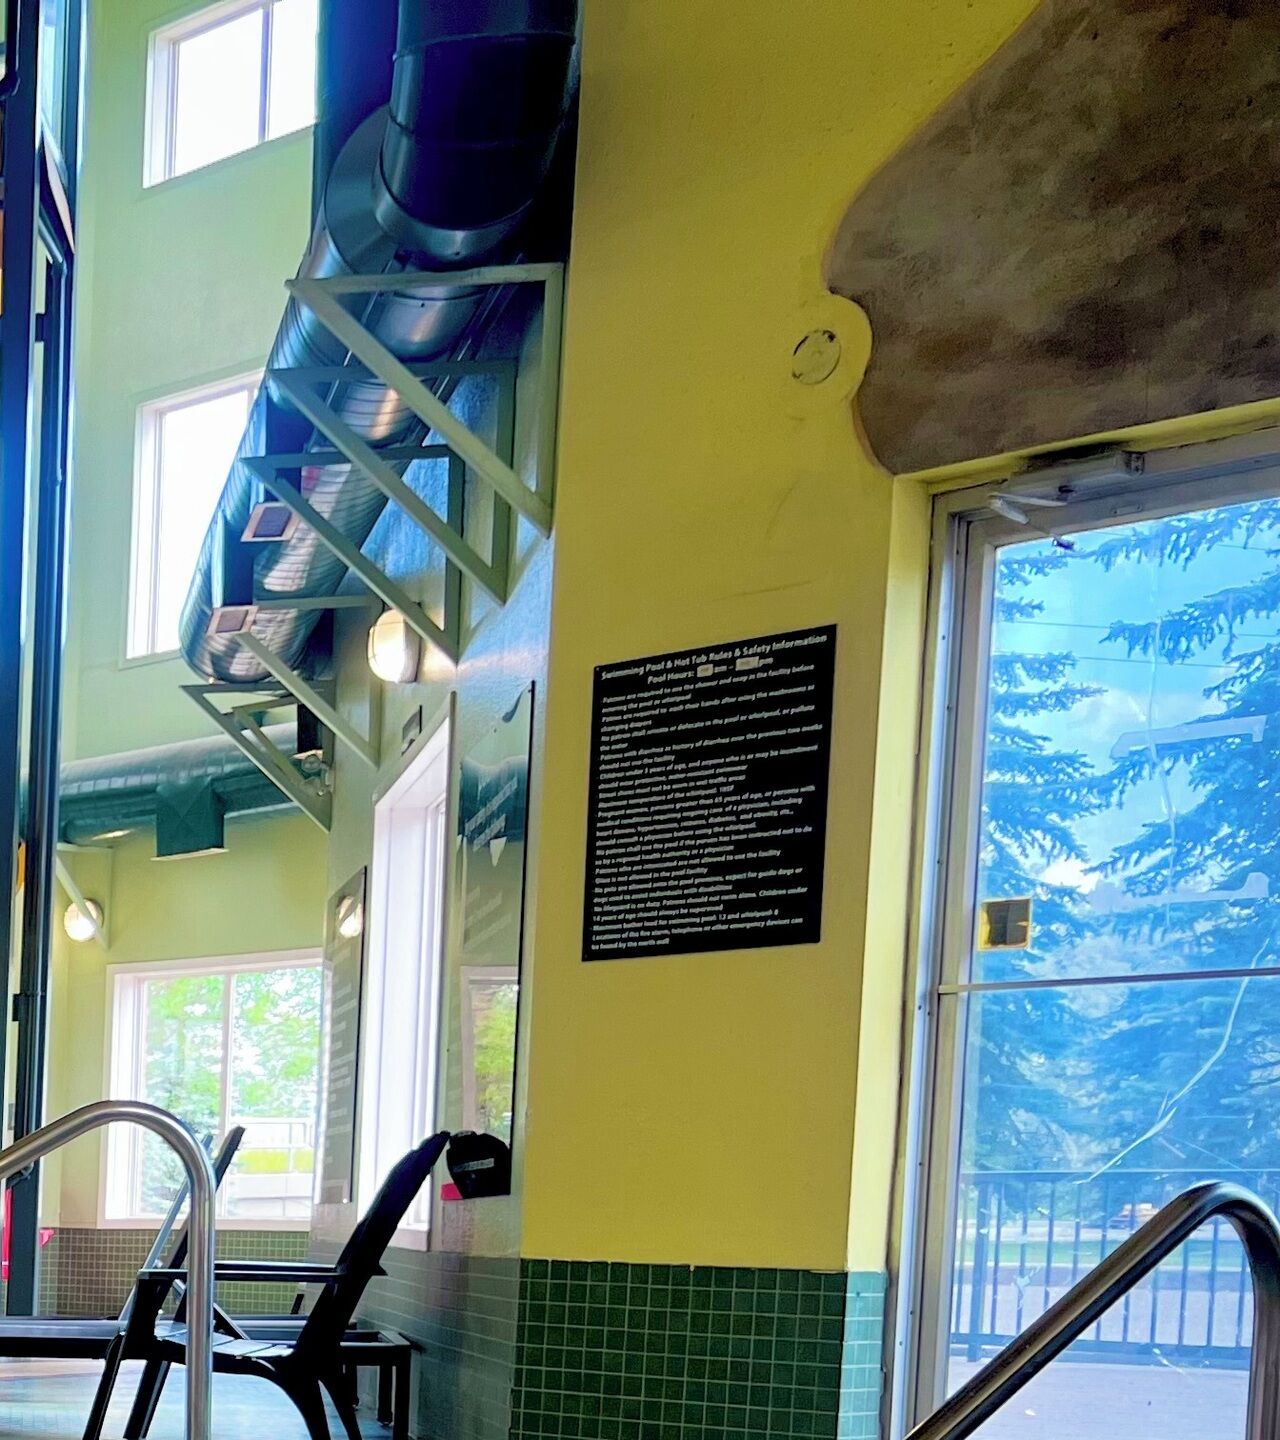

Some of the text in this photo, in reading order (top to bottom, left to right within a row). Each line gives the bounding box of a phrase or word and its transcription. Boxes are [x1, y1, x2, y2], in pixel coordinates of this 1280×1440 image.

[600, 665, 644, 680] Swimming
[645, 660, 665, 672] Pool
[665, 659, 672, 669] &
[673, 657, 690, 667] Hot
[691, 653, 707, 664] Tub
[708, 650, 732, 661] Rules
[733, 647, 740, 657] &
[742, 643, 770, 656] Safety
[771, 634, 827, 651] Information
[646, 672, 666, 684] Pool
